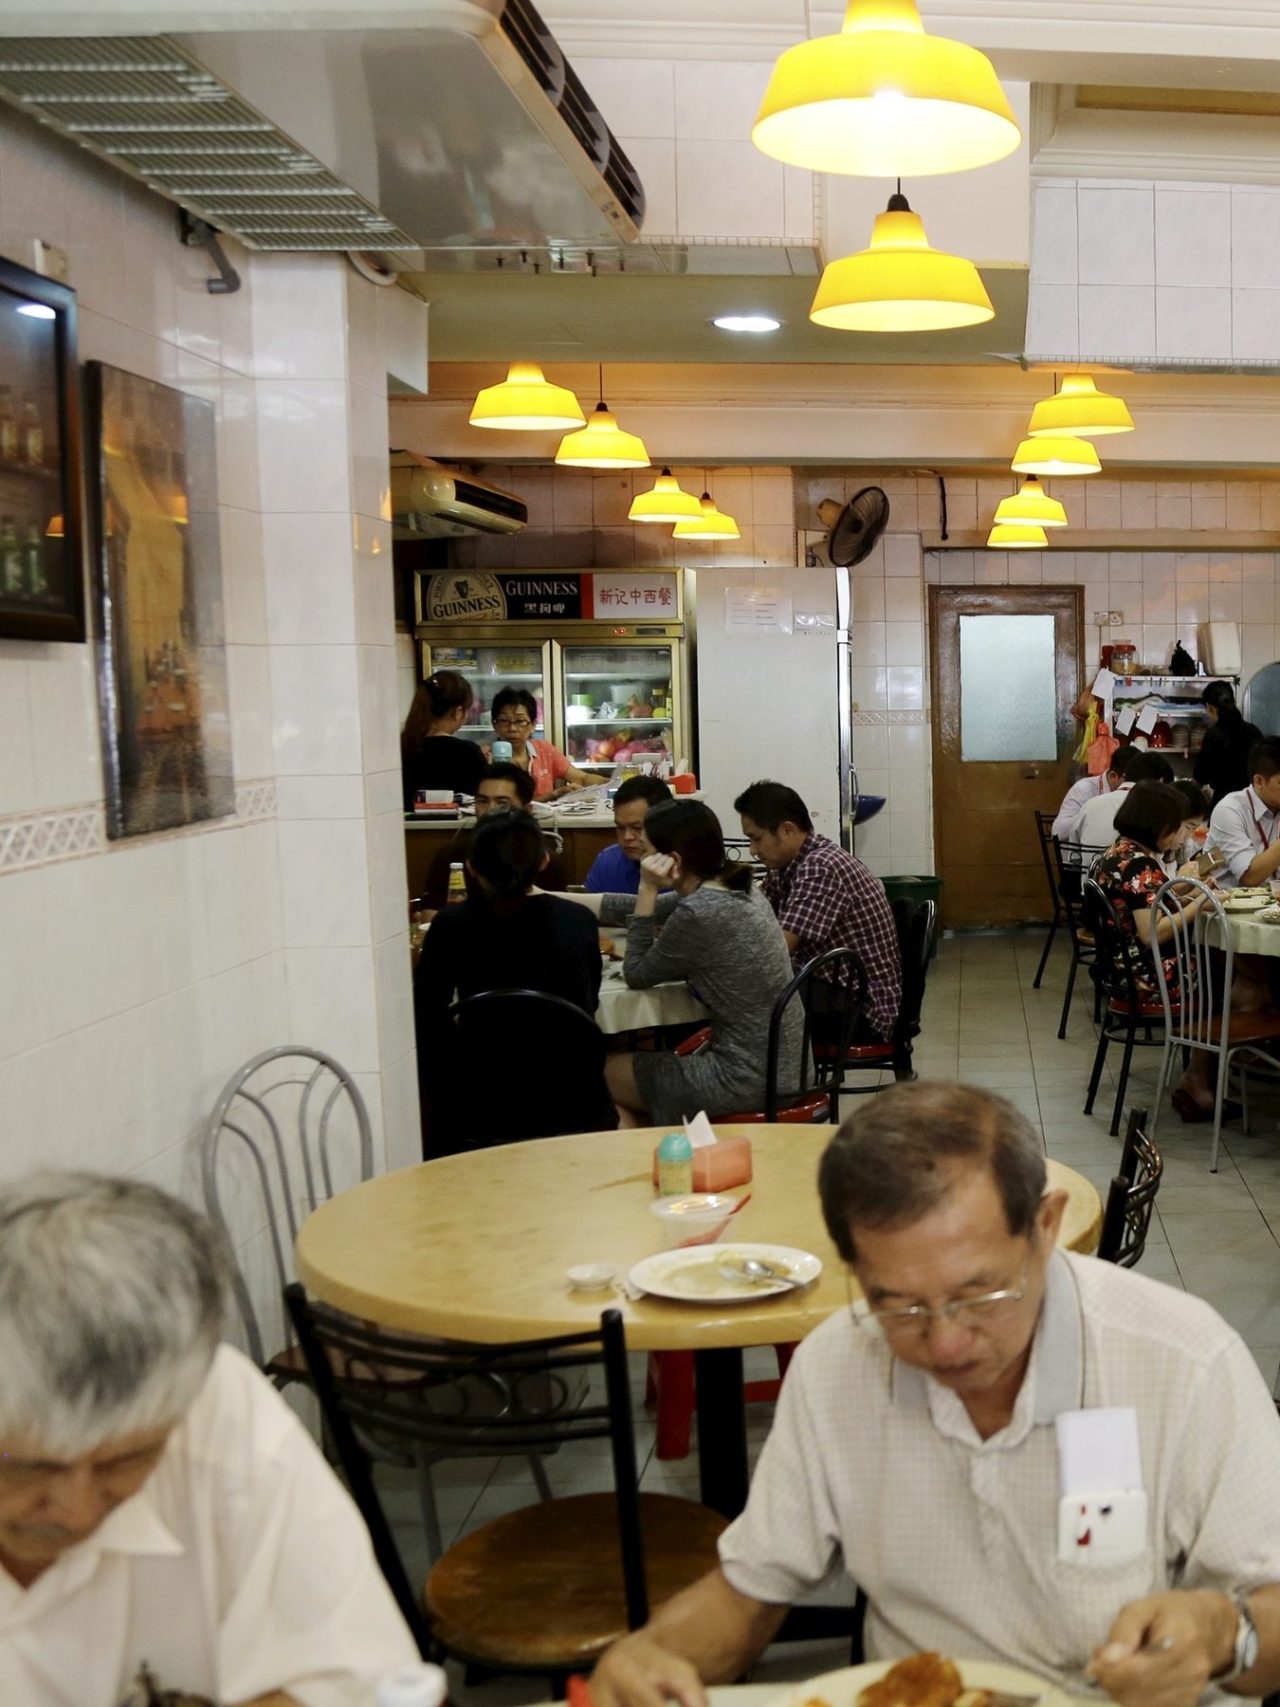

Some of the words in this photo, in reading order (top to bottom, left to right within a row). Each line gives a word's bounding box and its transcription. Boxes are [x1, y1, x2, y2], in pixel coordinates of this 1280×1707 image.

[505, 579, 578, 596] GUINNESS
[599, 586, 672, 606] 新记中西餐
[433, 595, 501, 618] GUINNESS
